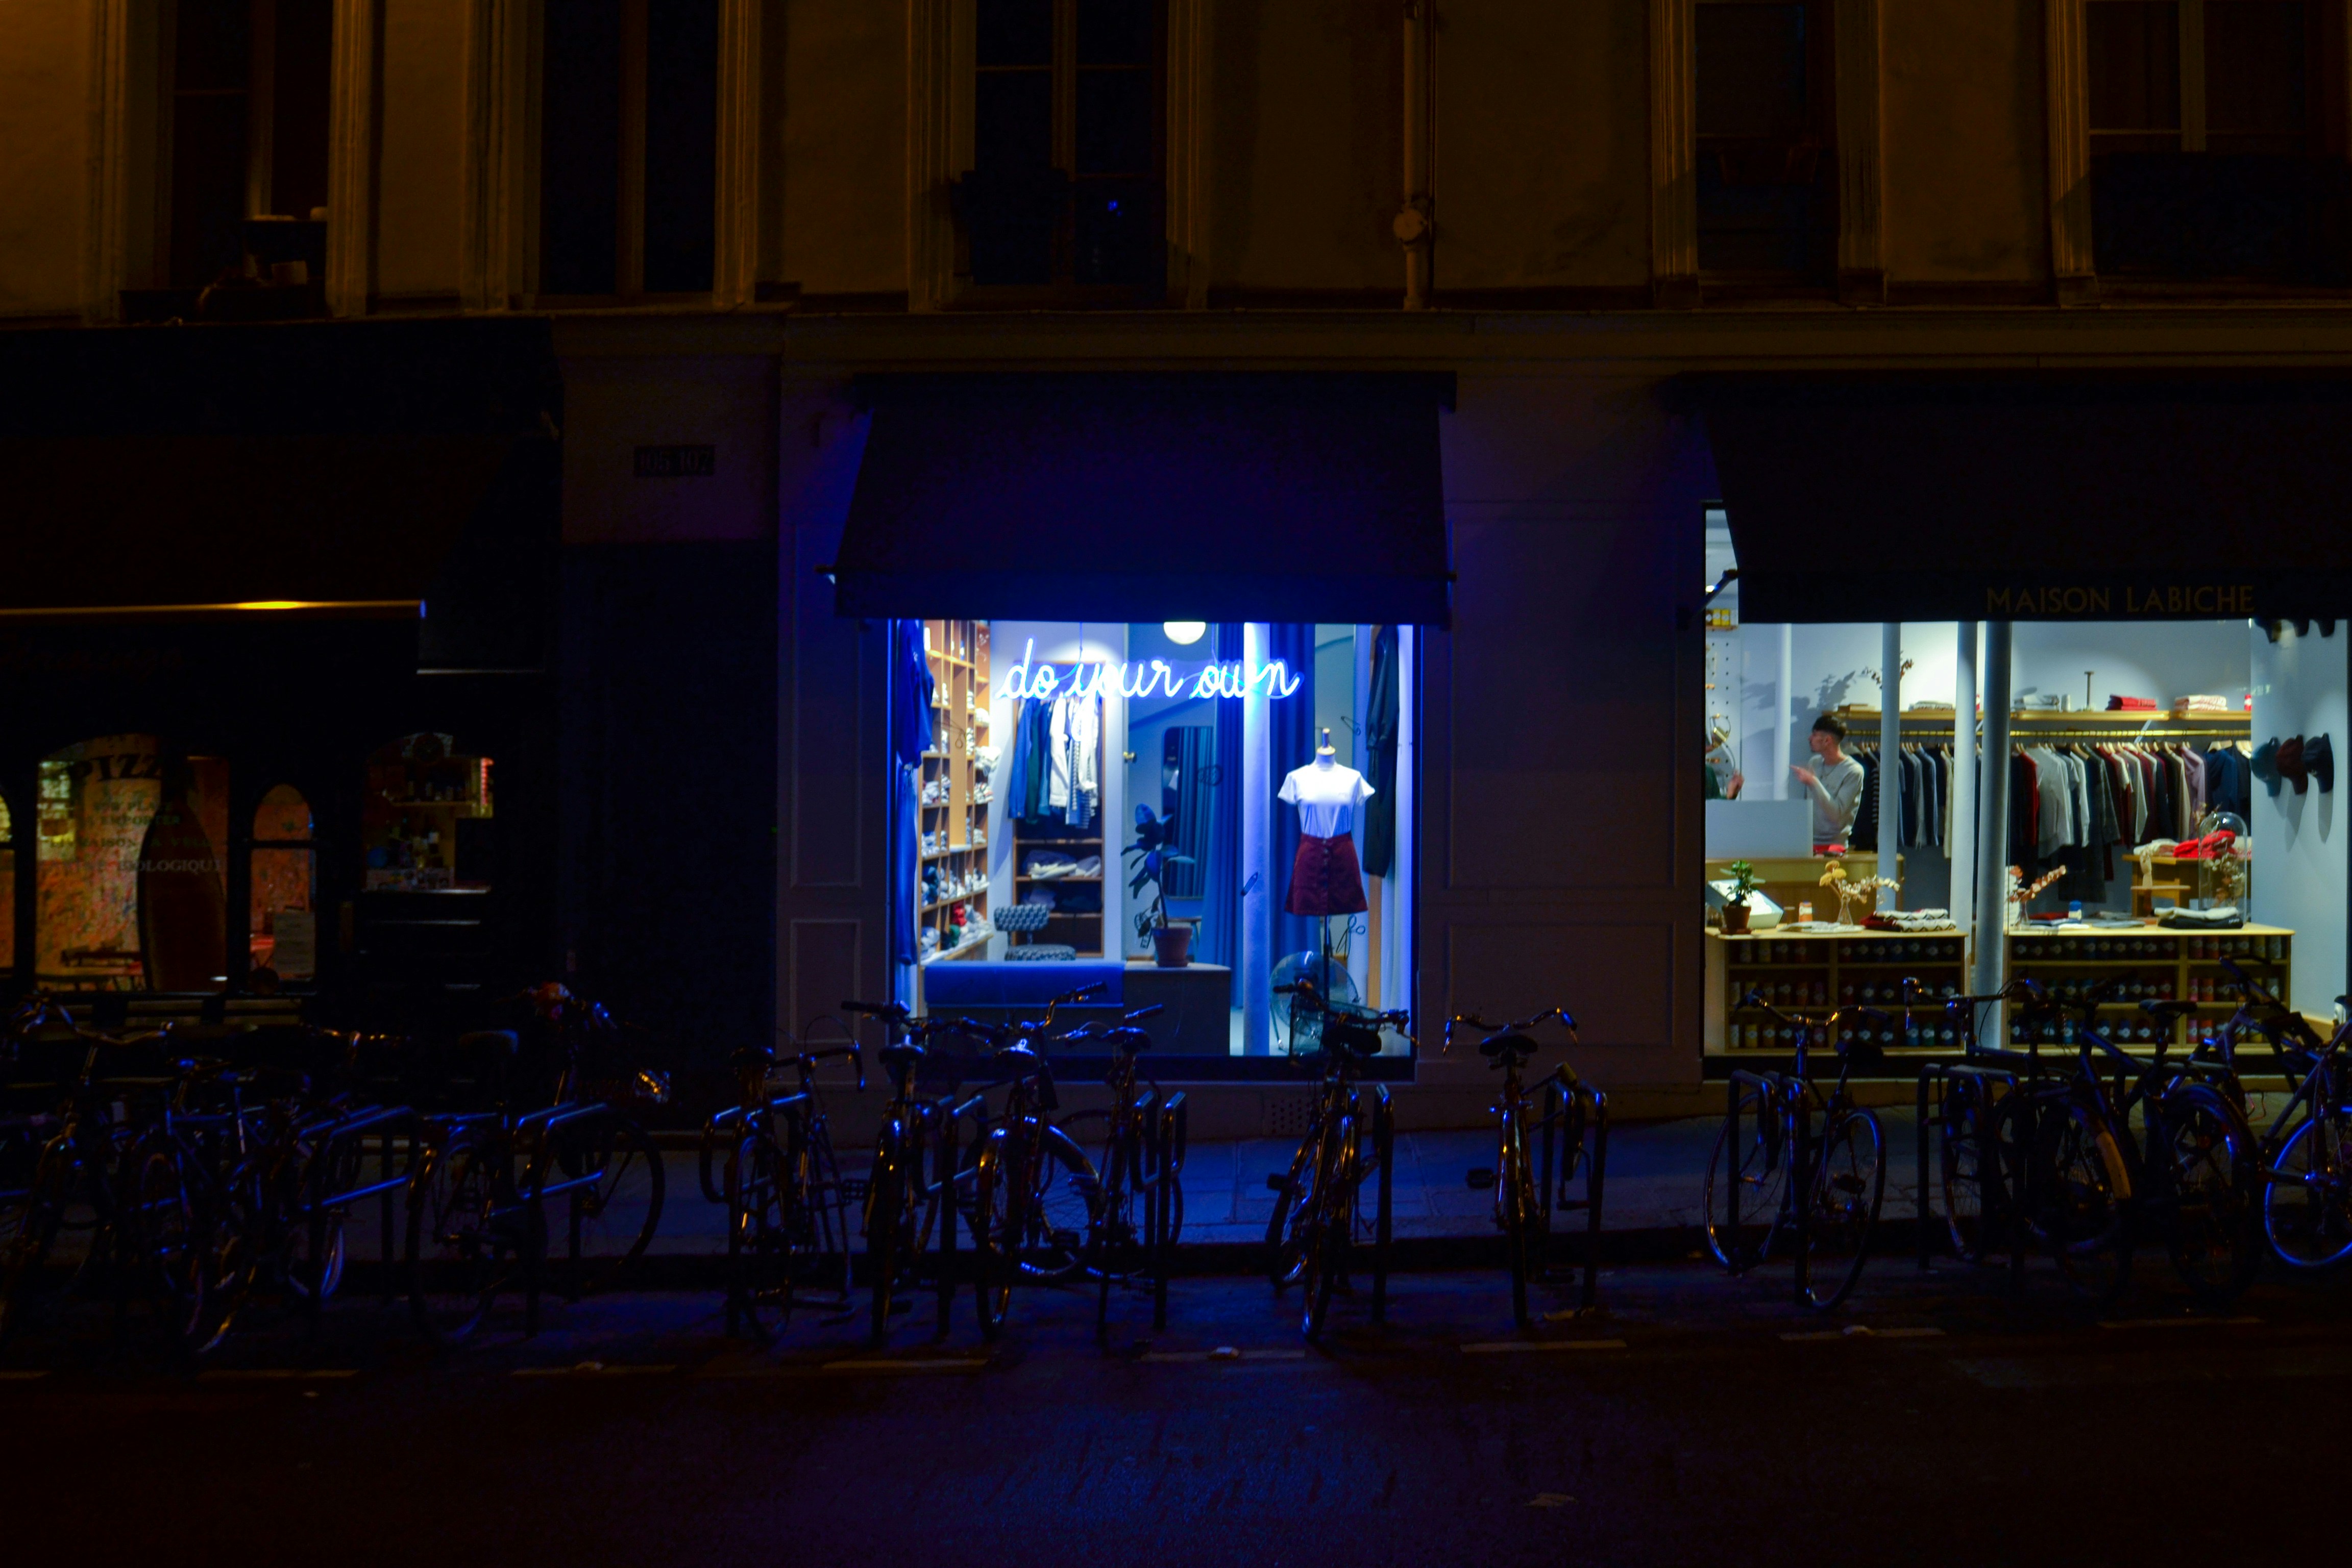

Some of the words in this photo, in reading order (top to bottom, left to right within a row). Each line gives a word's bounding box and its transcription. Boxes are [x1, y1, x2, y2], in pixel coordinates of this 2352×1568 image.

[1986, 585, 2111, 613] MAISON
[2125, 584, 2256, 613] LABICHE
[995, 638, 1060, 699] do
[1065, 660, 1185, 742] your
[1189, 662, 1301, 699] own
